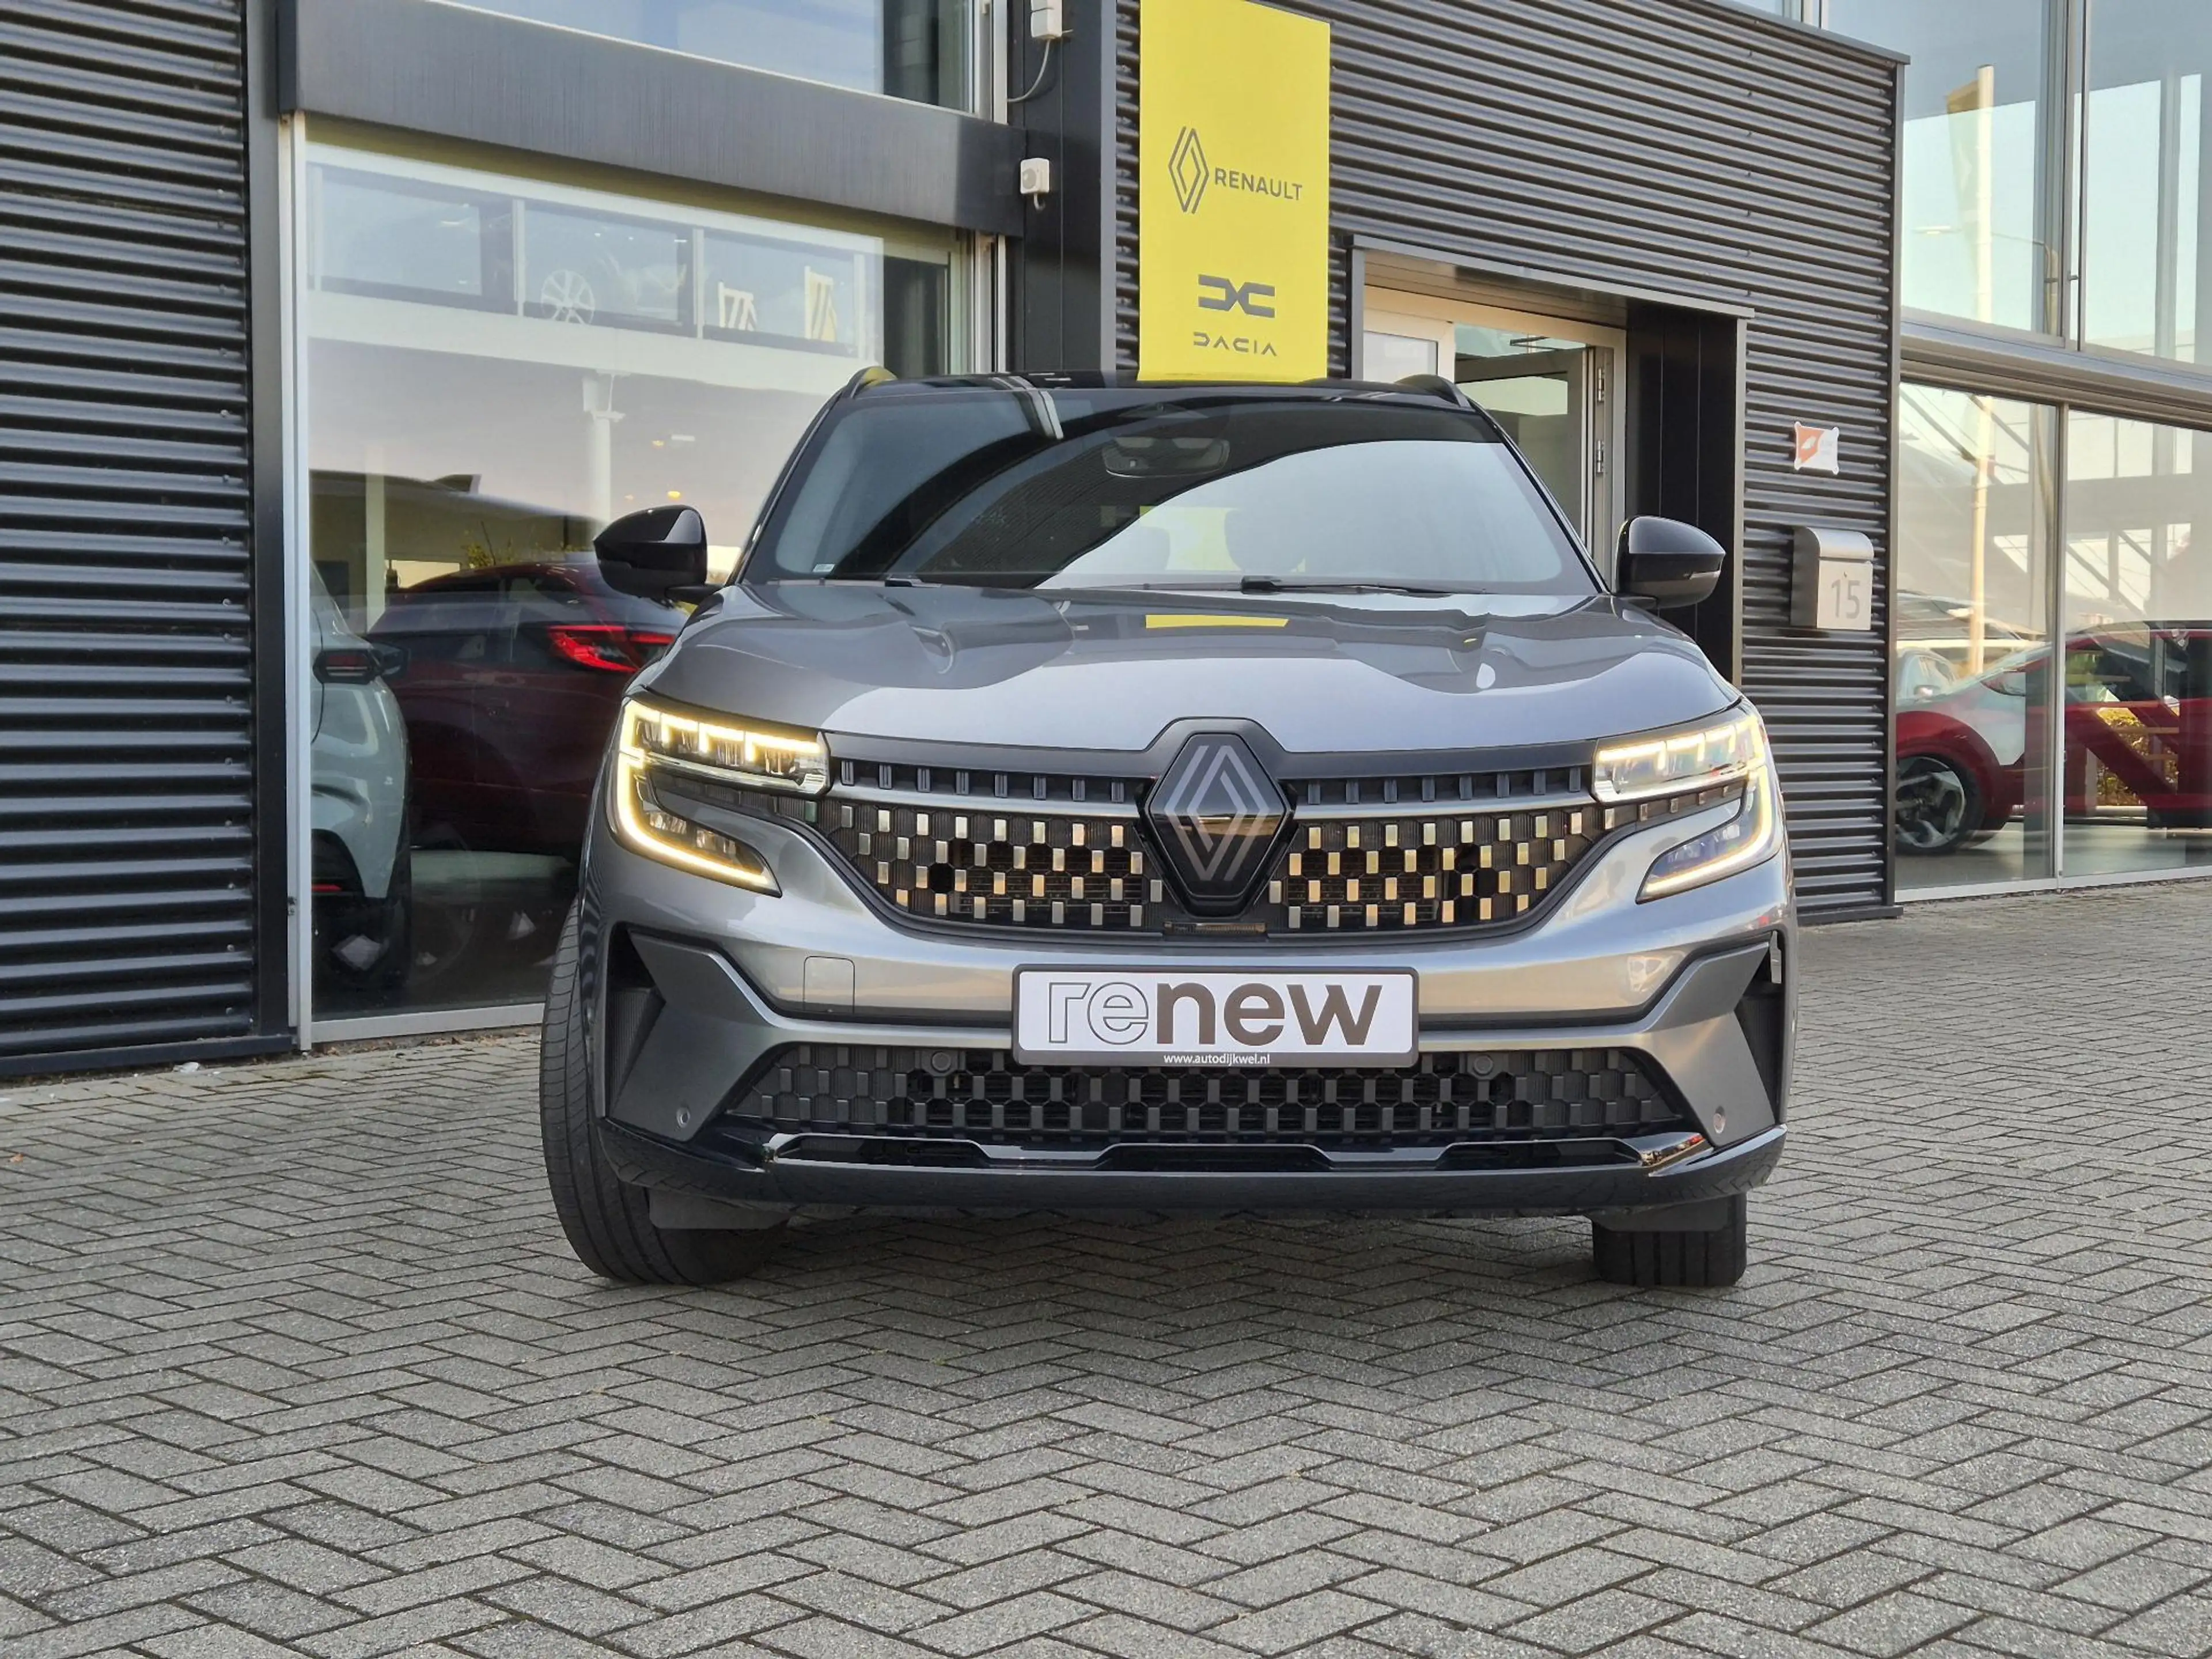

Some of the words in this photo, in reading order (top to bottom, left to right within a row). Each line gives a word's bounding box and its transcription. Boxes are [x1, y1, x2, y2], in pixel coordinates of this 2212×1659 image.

[1214, 167, 1302, 200] RENAULT
[1193, 331, 1277, 357] DACIA
[1831, 579, 1861, 619] 15
[1048, 982, 1382, 1046] renew
[1164, 1053, 1270, 1066] www.autodijkwel.nl
